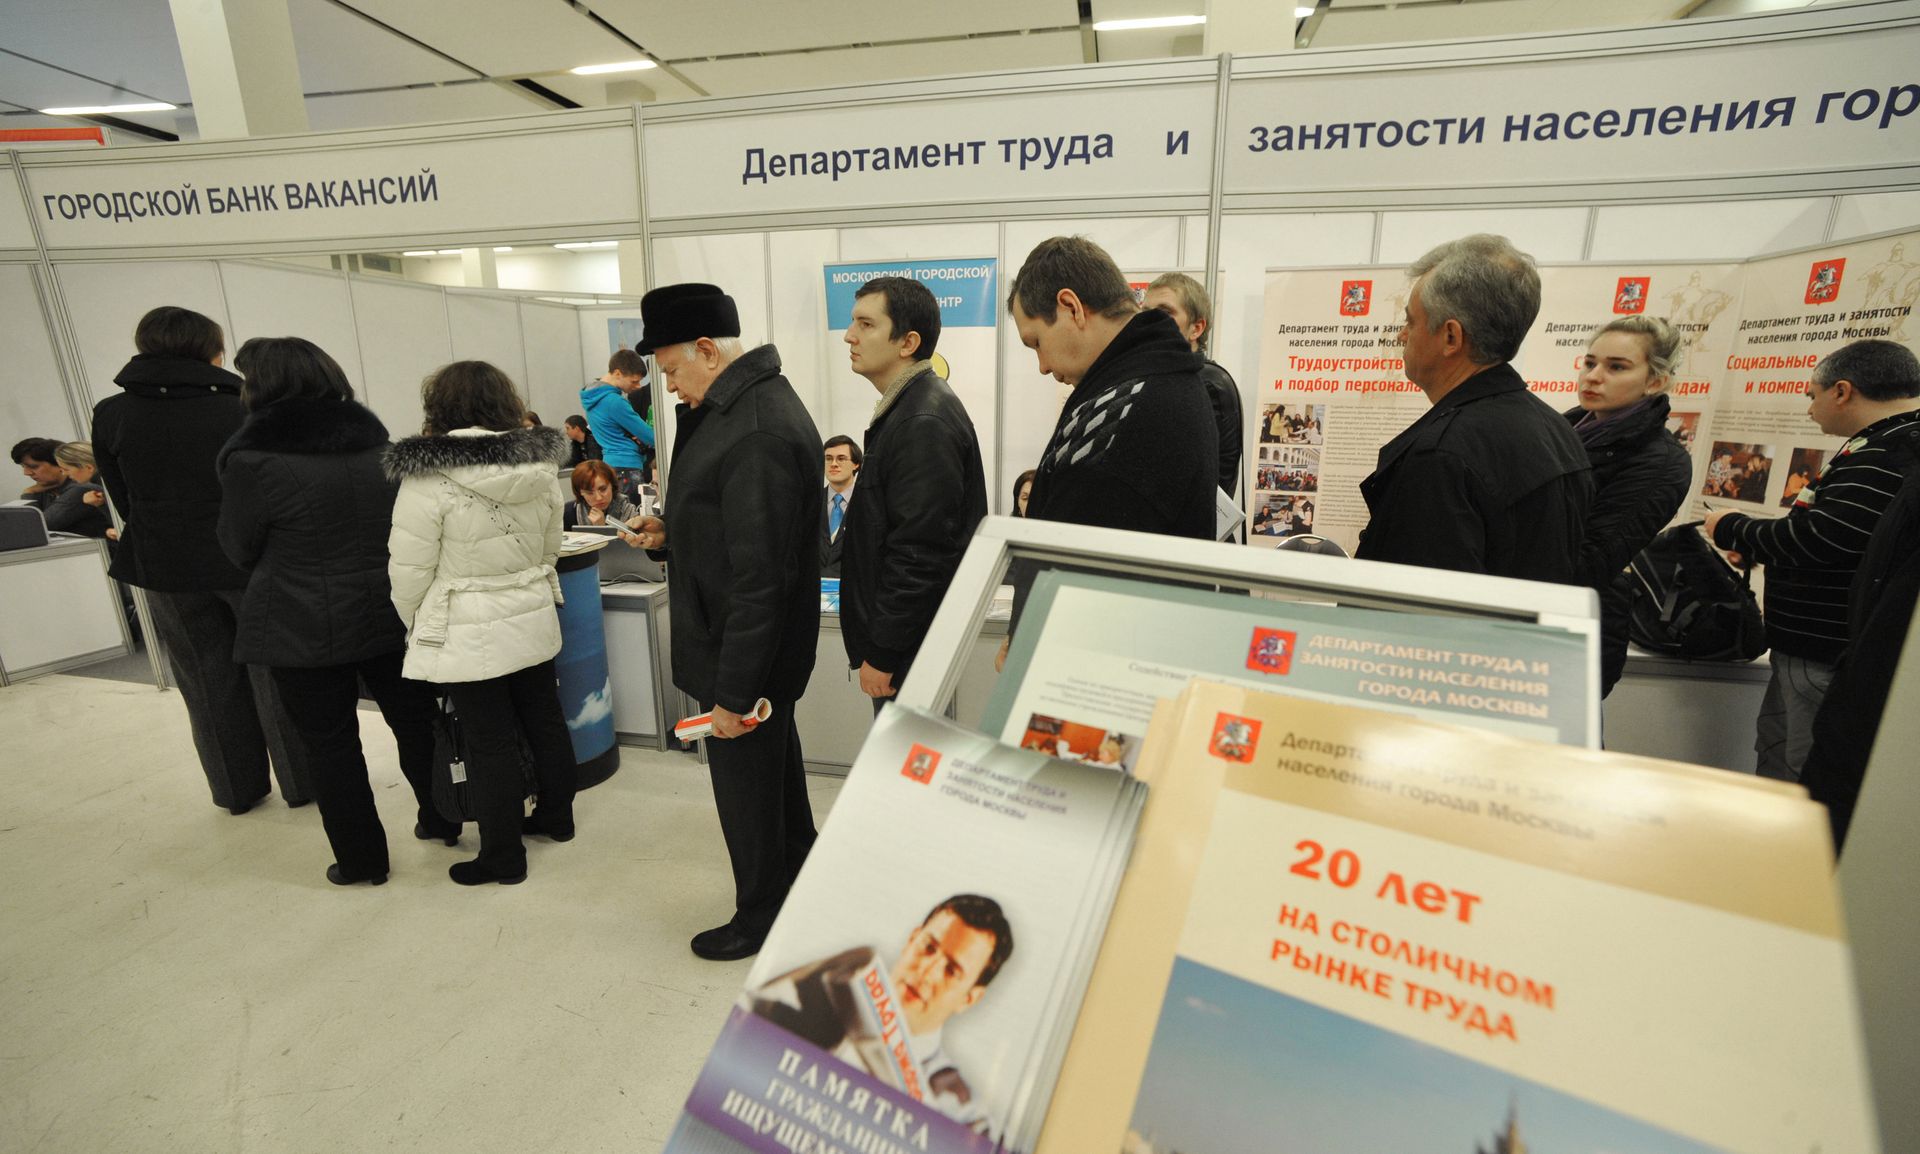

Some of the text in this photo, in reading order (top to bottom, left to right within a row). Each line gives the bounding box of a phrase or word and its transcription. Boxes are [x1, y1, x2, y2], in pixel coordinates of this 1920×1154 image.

[742, 139, 986, 185] Департамент
[997, 133, 1114, 170] труда
[1166, 130, 1190, 155] и
[1247, 116, 1486, 153] занятости
[1503, 96, 1797, 143] населения
[43, 167, 439, 223] ГОРОДСКОЙ БАНК ВАКАНСИЙ
[915, 265, 990, 280] ГОРОДСКОЙ
[1279, 324, 1339, 334] Департамент
[1342, 324, 1370, 334] труда
[1739, 305, 1911, 331] Департамент труда и занятости
[1288, 338, 1338, 347] населения
[1341, 338, 1374, 348] города
[1747, 325, 1891, 344] населения города Москвы
[1288, 355, 1405, 372] Трудоустройств
[1726, 354, 1818, 371] Социальные
[1274, 379, 1283, 390] и
[1288, 377, 1340, 393] подбор
[1744, 381, 1754, 394] и
[1309, 634, 1549, 676] ДЕПАРТАМЕНТ ТРУДА И
[1299, 651, 1549, 697] ЗАНЯТОСТИ НАСЕЛЕНИЯ
[1357, 680, 1549, 719] ГОРОДА МОСКВЫ
[1288, 839, 1483, 925] 20 лет
[1278, 903, 1557, 1011] НА СТОЛИЧНОМ
[1270, 938, 1520, 1043] РЫНКЕ ТРУДА
[777, 1047, 929, 1151] ПАМЯТКА
